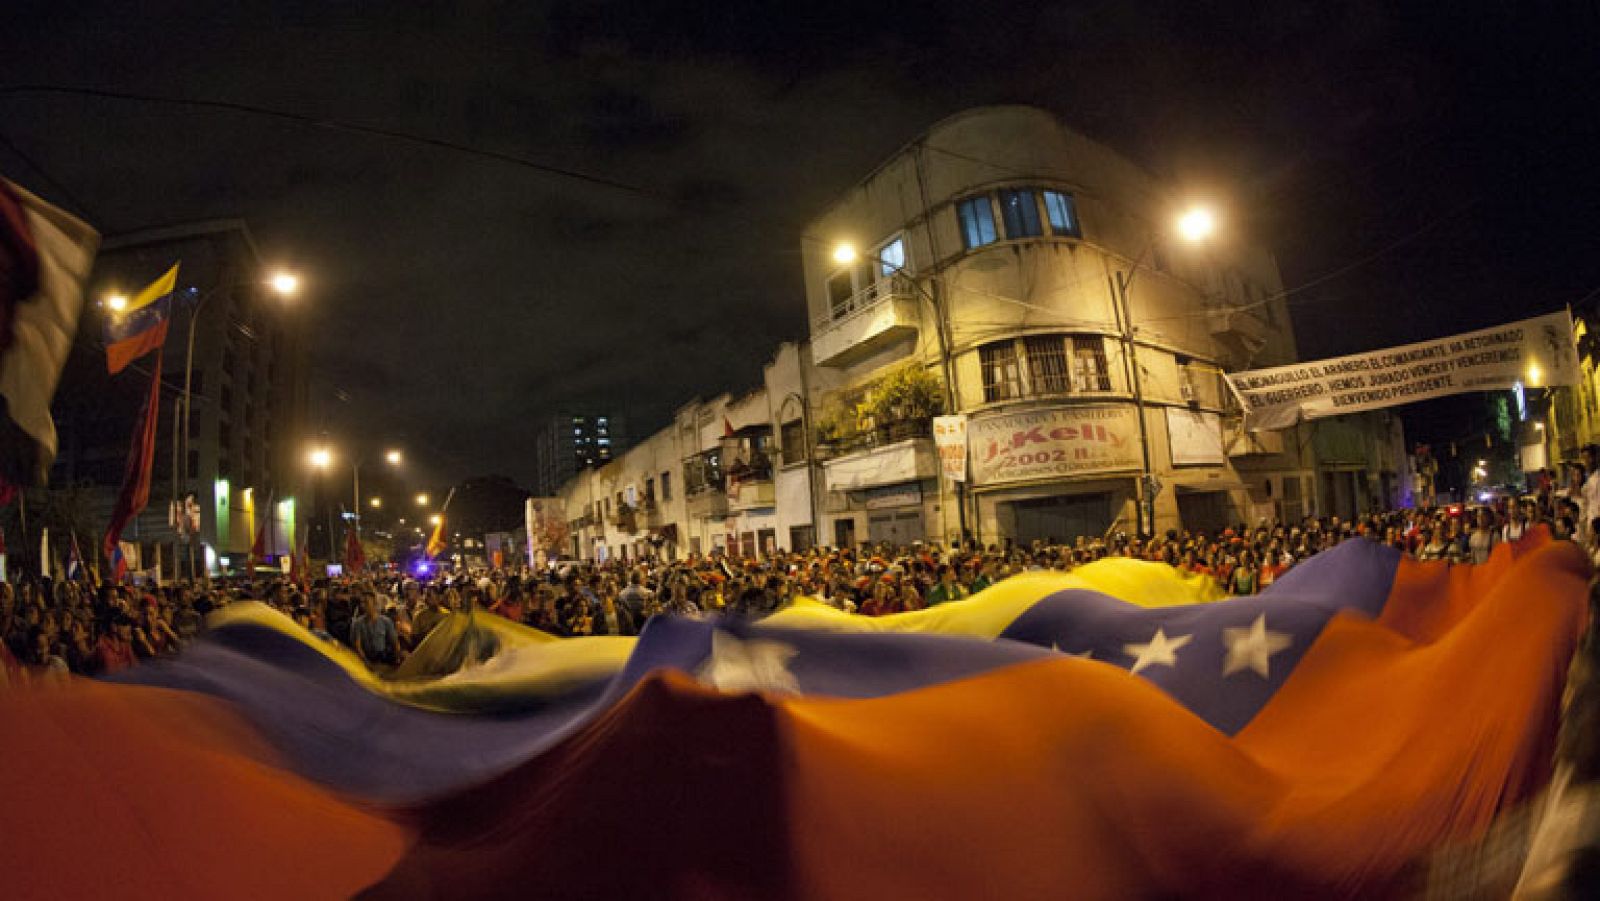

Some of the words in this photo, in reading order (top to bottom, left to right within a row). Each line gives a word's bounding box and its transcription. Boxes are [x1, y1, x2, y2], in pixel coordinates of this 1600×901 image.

[1249, 394, 1266, 408] EL
[1328, 376, 1366, 392] HEMOS
[1370, 367, 1408, 387] JURADO
[1001, 450, 1066, 468] 2002
